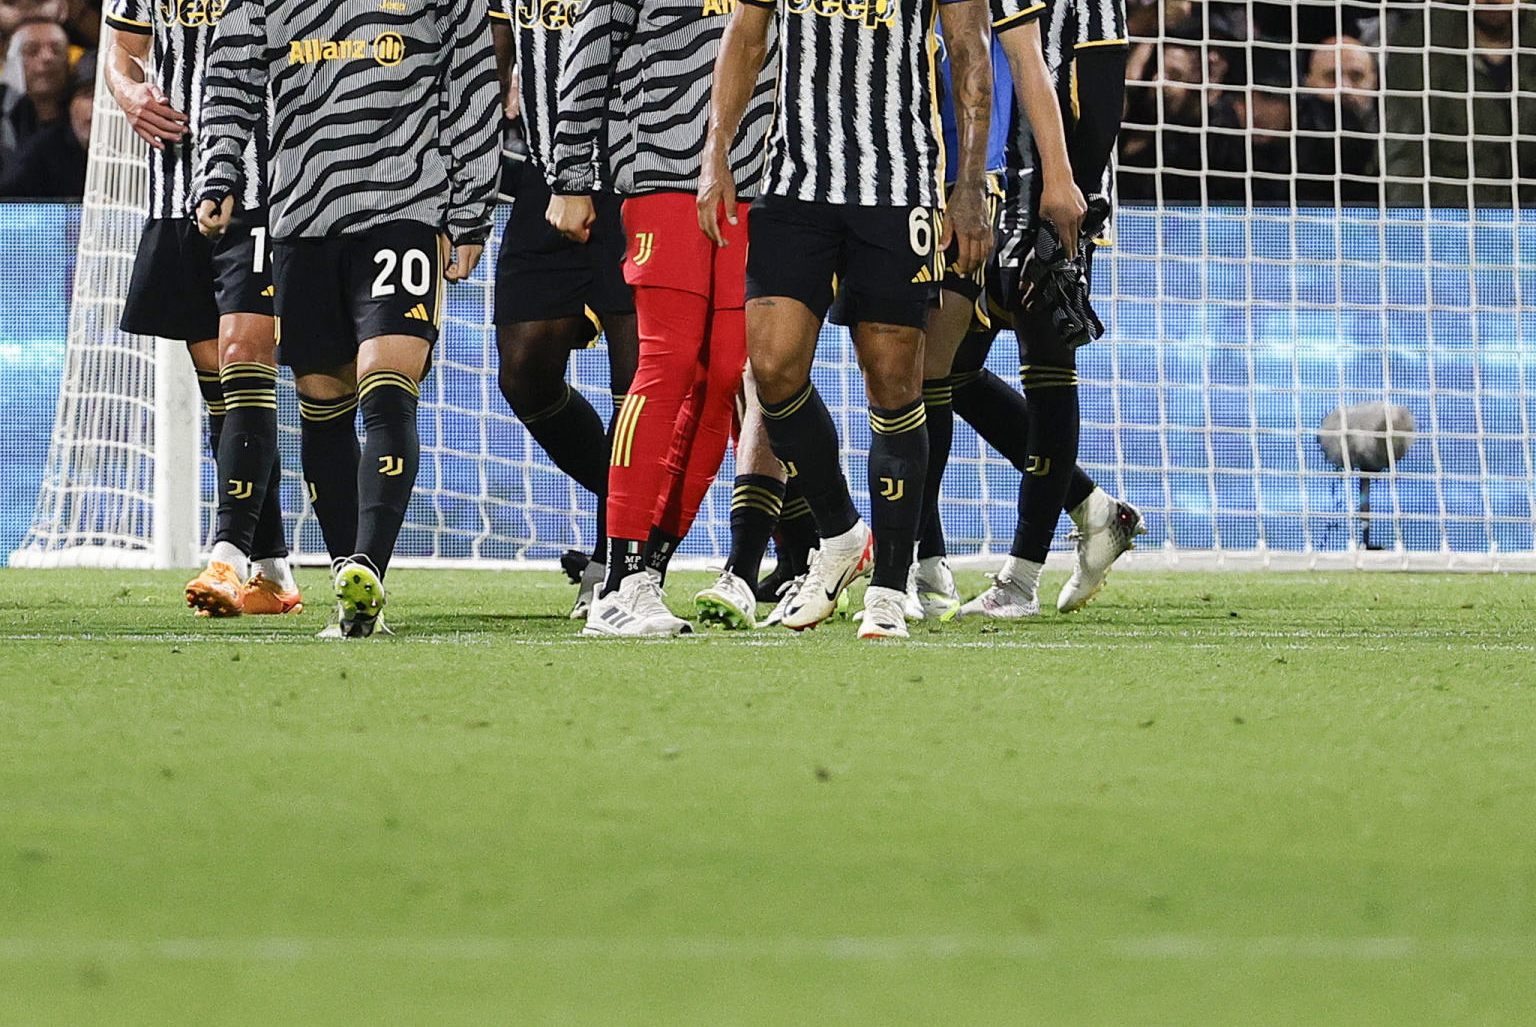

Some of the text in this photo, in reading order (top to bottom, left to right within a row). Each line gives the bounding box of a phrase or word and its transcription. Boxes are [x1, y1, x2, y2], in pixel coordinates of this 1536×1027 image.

[288, 38, 366, 66] Allianz
[250, 226, 274, 273] 1
[908, 206, 932, 257] 6
[371, 248, 431, 298] 20
[624, 555, 642, 564] MP
